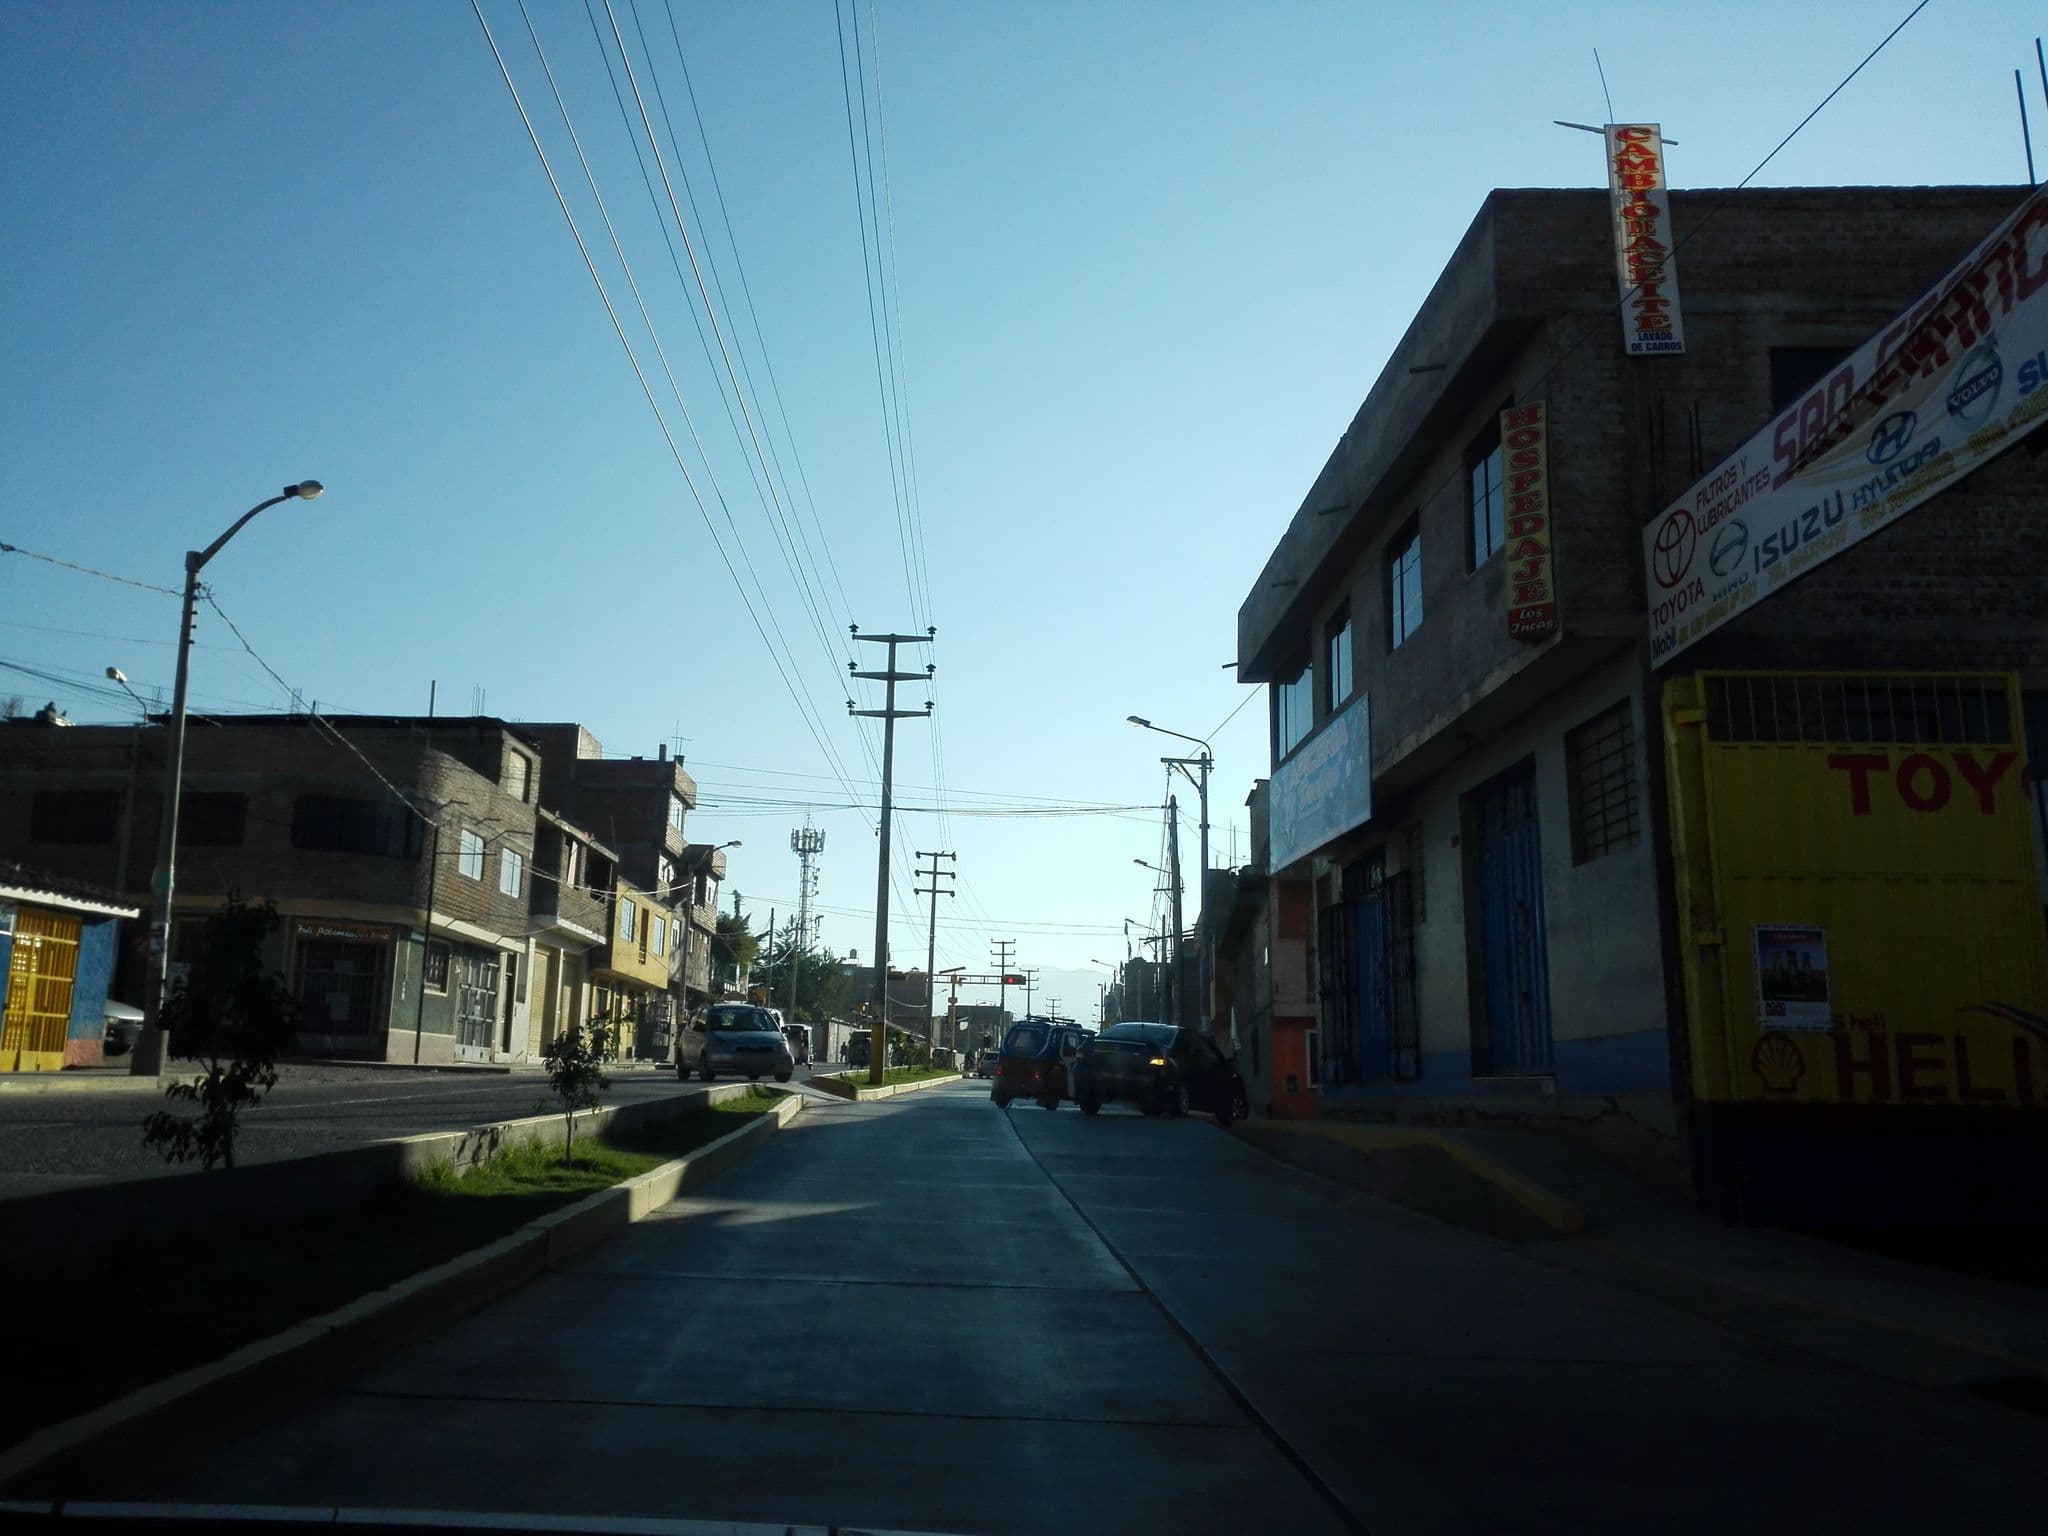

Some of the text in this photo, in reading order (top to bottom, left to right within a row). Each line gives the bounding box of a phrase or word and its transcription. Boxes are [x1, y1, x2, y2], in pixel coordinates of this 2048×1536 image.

[1614, 127, 1672, 332] CAMBIO DE ACEITE
[1631, 343, 1683, 352] DE CARROS
[1638, 332, 1673, 342] LAVADO
[1950, 367, 2001, 408] VOLVO
[1696, 455, 1748, 511] FILTROS Y
[1697, 465, 1770, 536] LUBRICANTES
[1853, 435, 1942, 511] HYUNDAI
[1502, 405, 1549, 605] HOSPEDAJE
[1753, 489, 1844, 575] ISUZU
[1519, 607, 1544, 620] Los
[1652, 576, 1705, 630] TOYOTA
[1652, 625, 1677, 659] Mobil
[1828, 752, 2034, 816] TOY
